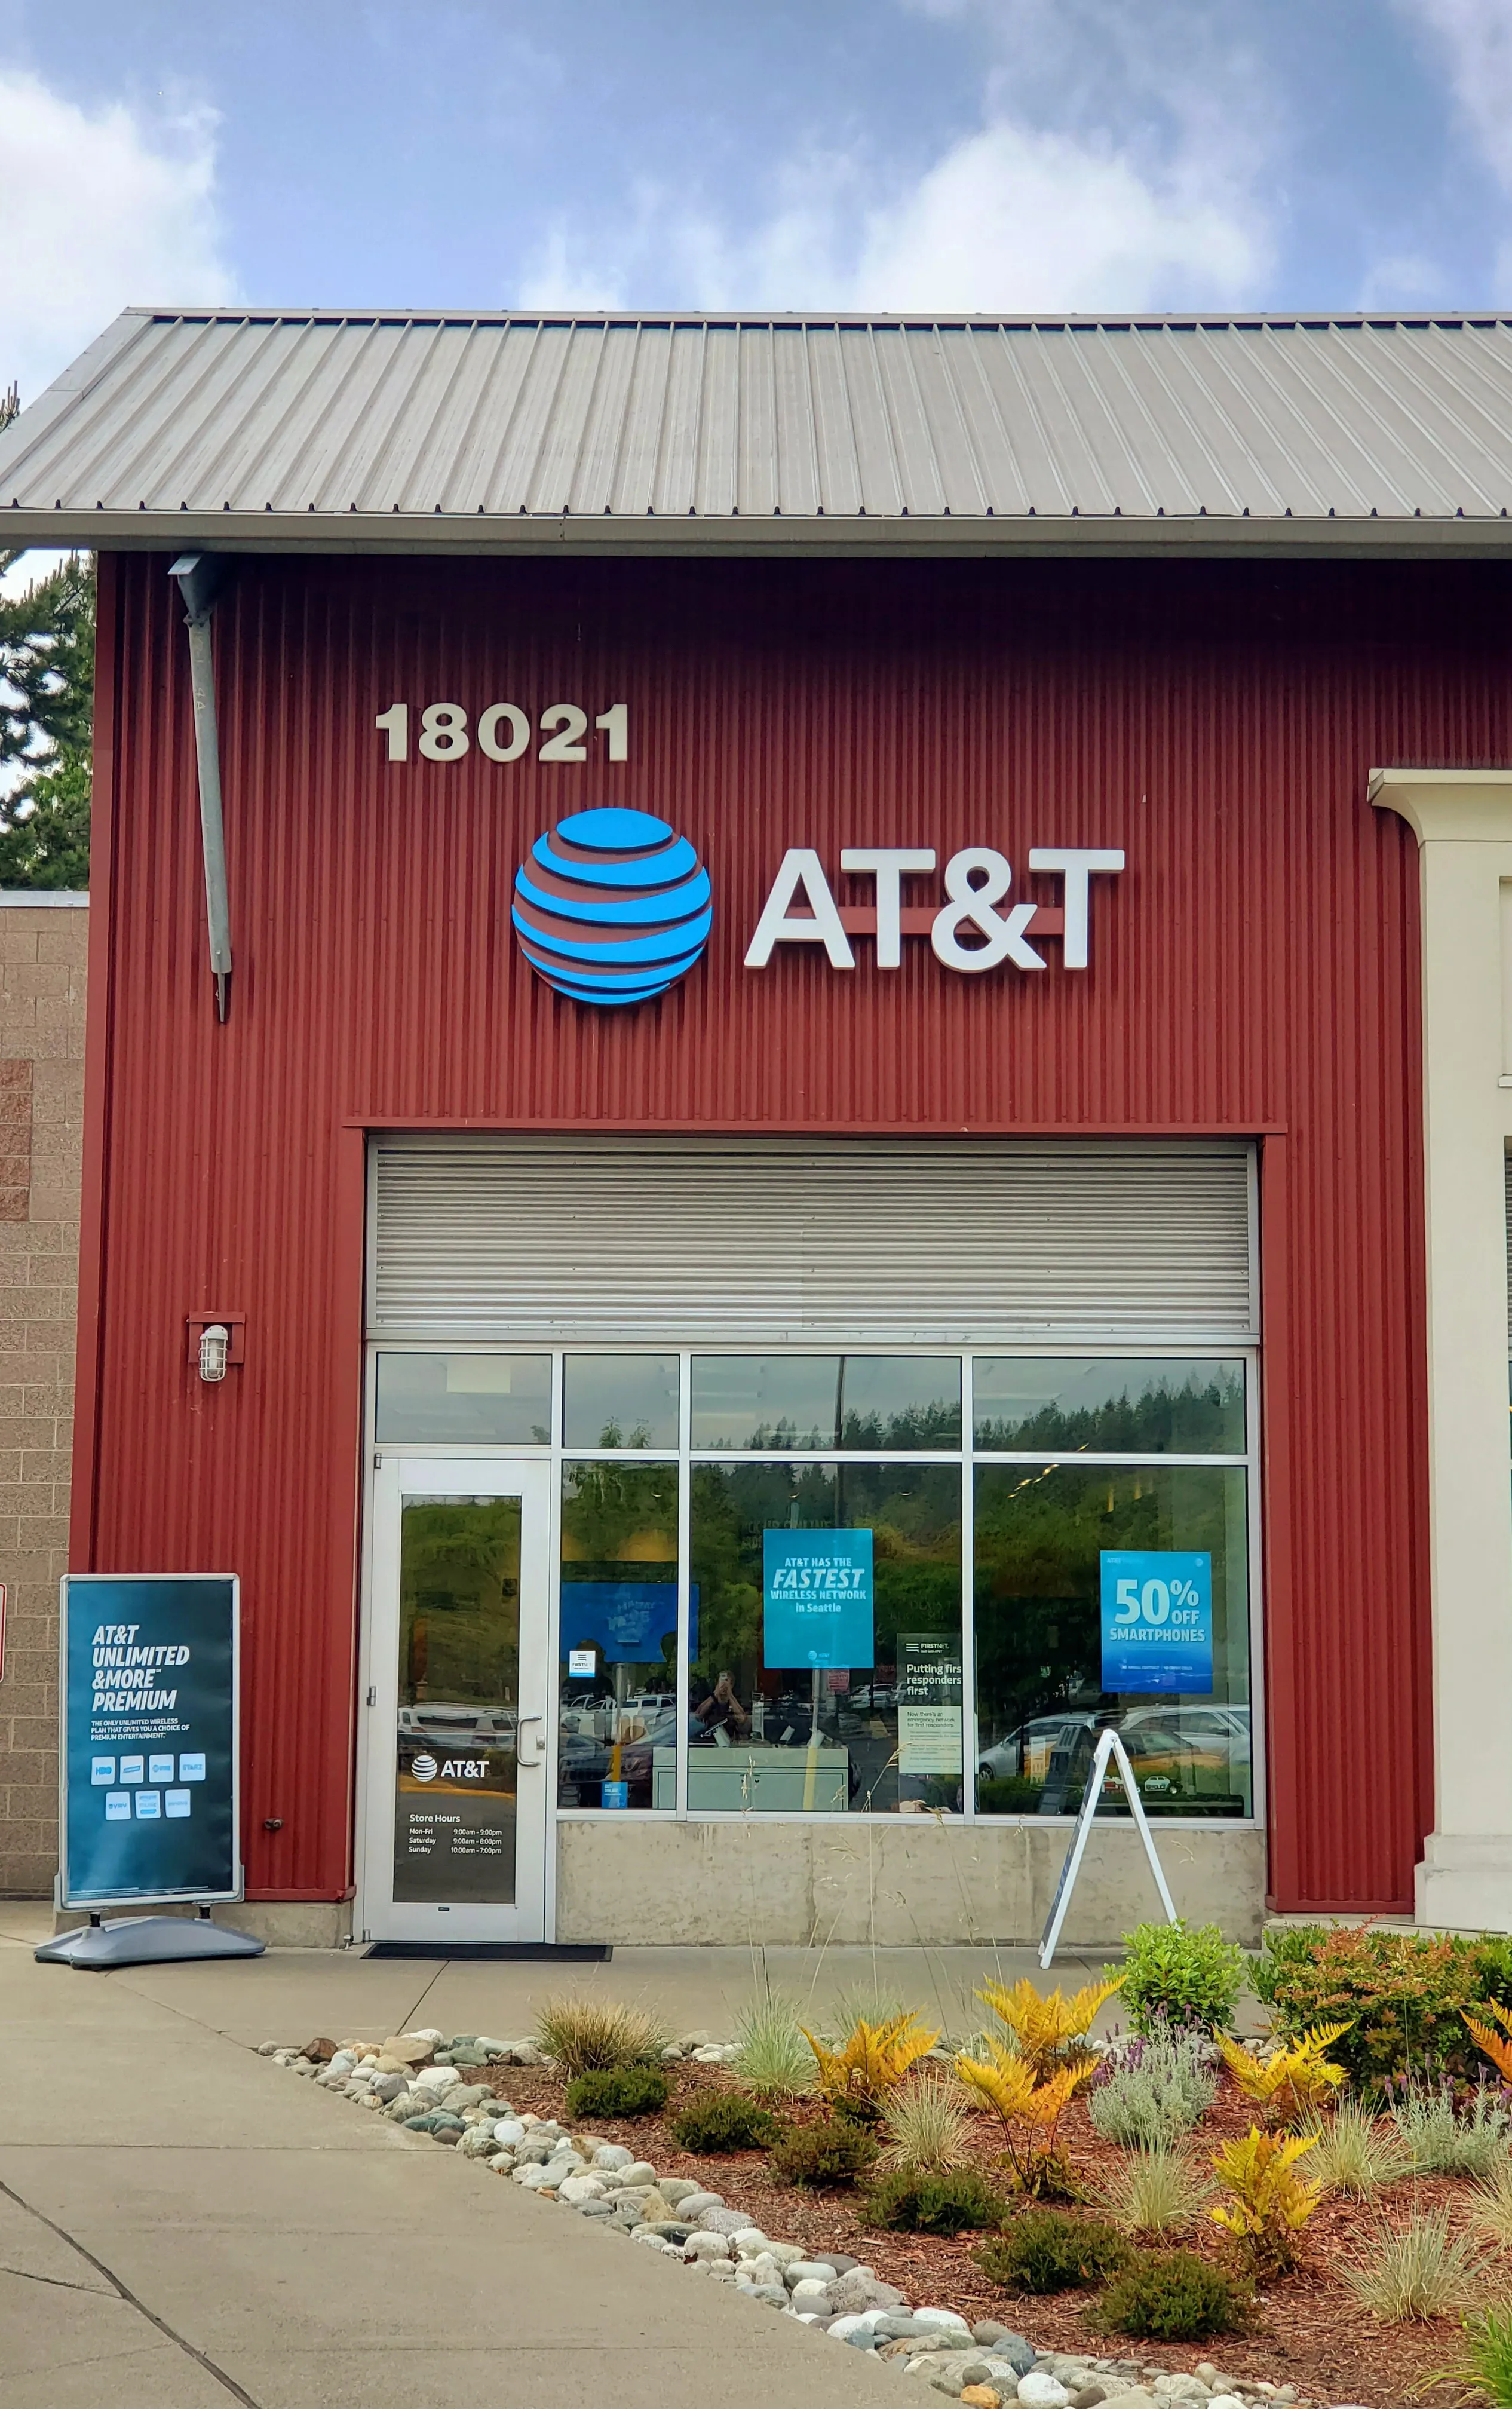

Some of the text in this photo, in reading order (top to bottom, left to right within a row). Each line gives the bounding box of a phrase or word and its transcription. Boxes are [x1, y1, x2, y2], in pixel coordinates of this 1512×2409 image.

[375, 703, 628, 762] 18021
[744, 847, 1125, 973] AT&T
[784, 1558, 852, 1567] AT&T HAS THE
[772, 1568, 865, 1589] FASTEST
[771, 1590, 866, 1599] WIRELESS NETWORK
[1115, 1579, 1200, 1625] 50% OFF
[796, 1602, 841, 1613] in Seattle
[91, 1625, 140, 1645] AT&T
[1109, 1628, 1205, 1642] SMARTPHONES
[92, 1645, 190, 1667] UNLIMITED
[907, 1664, 962, 1675] Putting firs
[907, 1675, 962, 1686] responders
[907, 1686, 928, 1695] first
[91, 1690, 177, 1712] PREMIUM
[440, 1760, 489, 1778] AT&T
[409, 1814, 461, 1823] Store Hours
